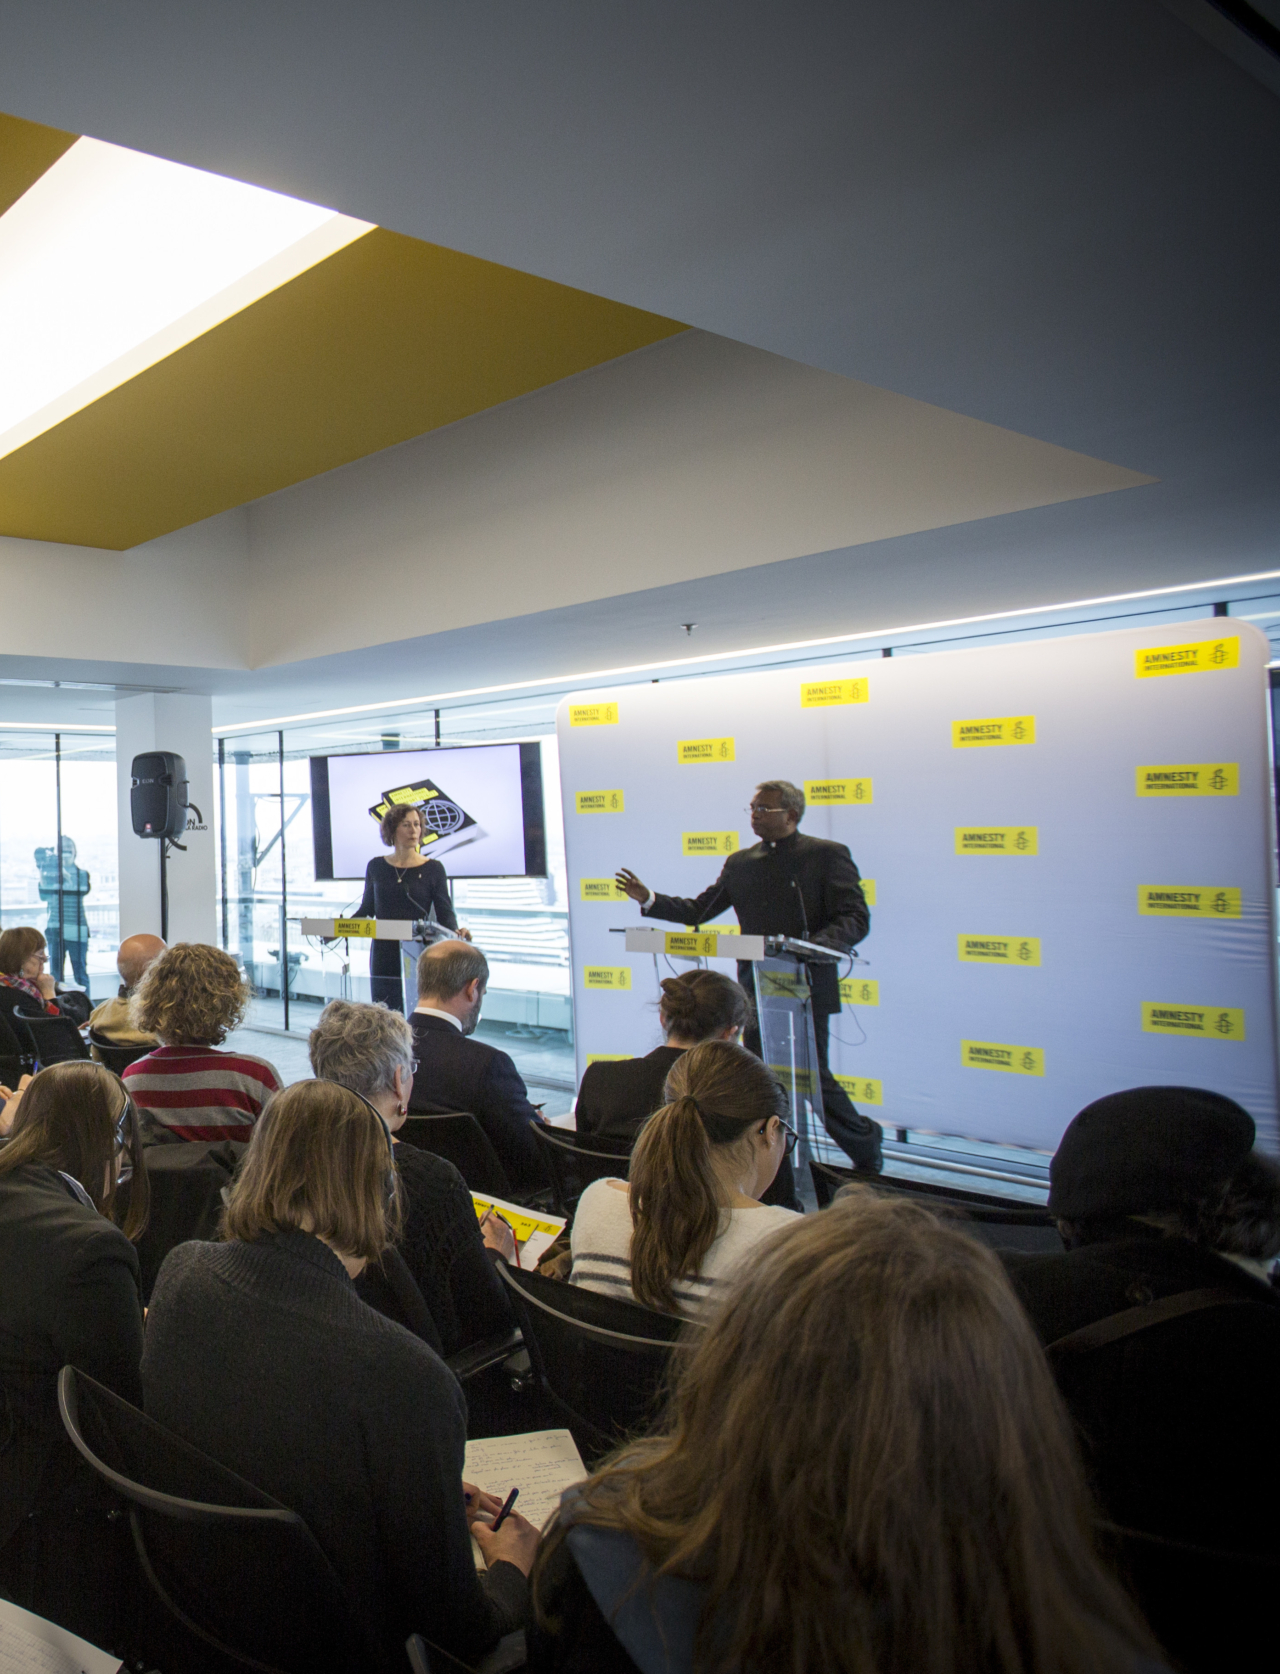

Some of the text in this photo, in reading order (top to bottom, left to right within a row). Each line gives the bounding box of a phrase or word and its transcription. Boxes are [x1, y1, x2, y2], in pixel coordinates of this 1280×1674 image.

[1144, 650, 1198, 664] AMNESTY
[1144, 660, 1198, 671] INTERNATIONAL
[807, 685, 843, 695] AMNESTY
[807, 694, 843, 702] INTERNATIONAL
[574, 708, 600, 717] AMNESTY
[960, 724, 1003, 735] AMNESTY
[683, 744, 713, 753] AMNESTY
[1146, 772, 1199, 782] AMNESTY
[811, 785, 846, 794] AMNESTY
[580, 795, 606, 803] AMNESTY
[688, 837, 718, 845] AMNESTY
[962, 833, 1005, 842] AMNESTY
[585, 883, 610, 891] AMNESTY
[1148, 892, 1201, 903] AMNESTY
[1147, 902, 1202, 910] INTERNATIONAL
[671, 937, 697, 945] AMNESTY
[965, 940, 1008, 951] AMNESTY
[965, 949, 1009, 958] INTERNATIONAL
[588, 971, 613, 979] AMNESTY
[1151, 1009, 1205, 1022] AMNESTY
[1151, 1020, 1205, 1030] INTERNATIONAL
[969, 1046, 1012, 1059] AMNESTY
